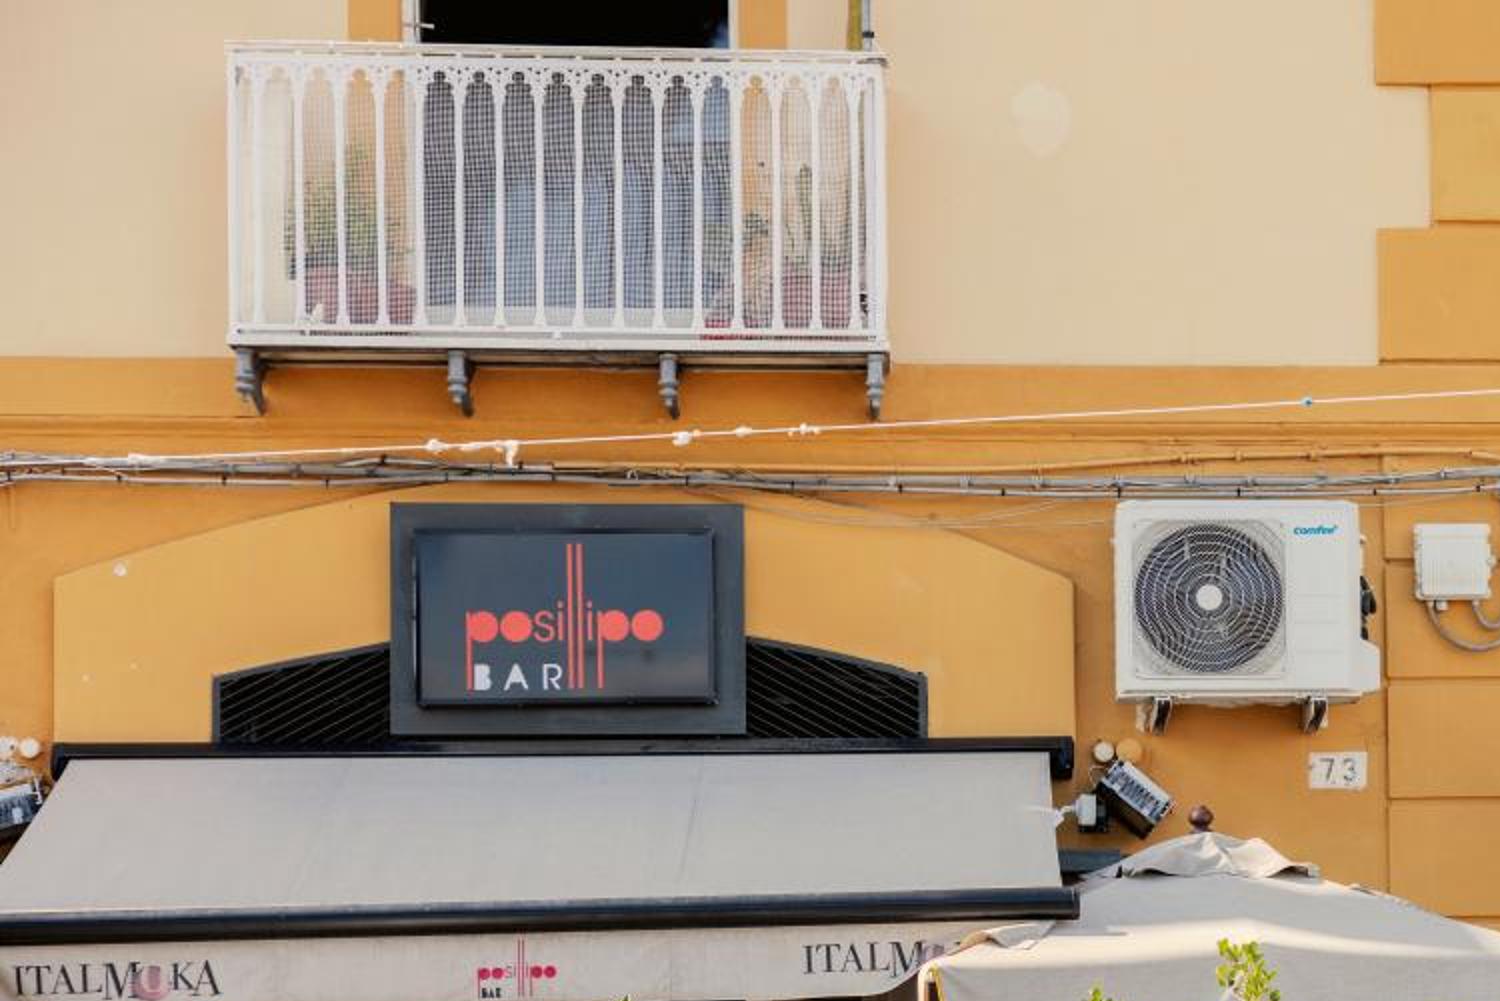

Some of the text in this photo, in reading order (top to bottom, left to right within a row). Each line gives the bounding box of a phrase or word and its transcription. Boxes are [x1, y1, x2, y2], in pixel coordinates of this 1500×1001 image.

[466, 543, 663, 690] posillipo
[474, 663, 562, 690] BAR
[1318, 757, 1356, 782] 73
